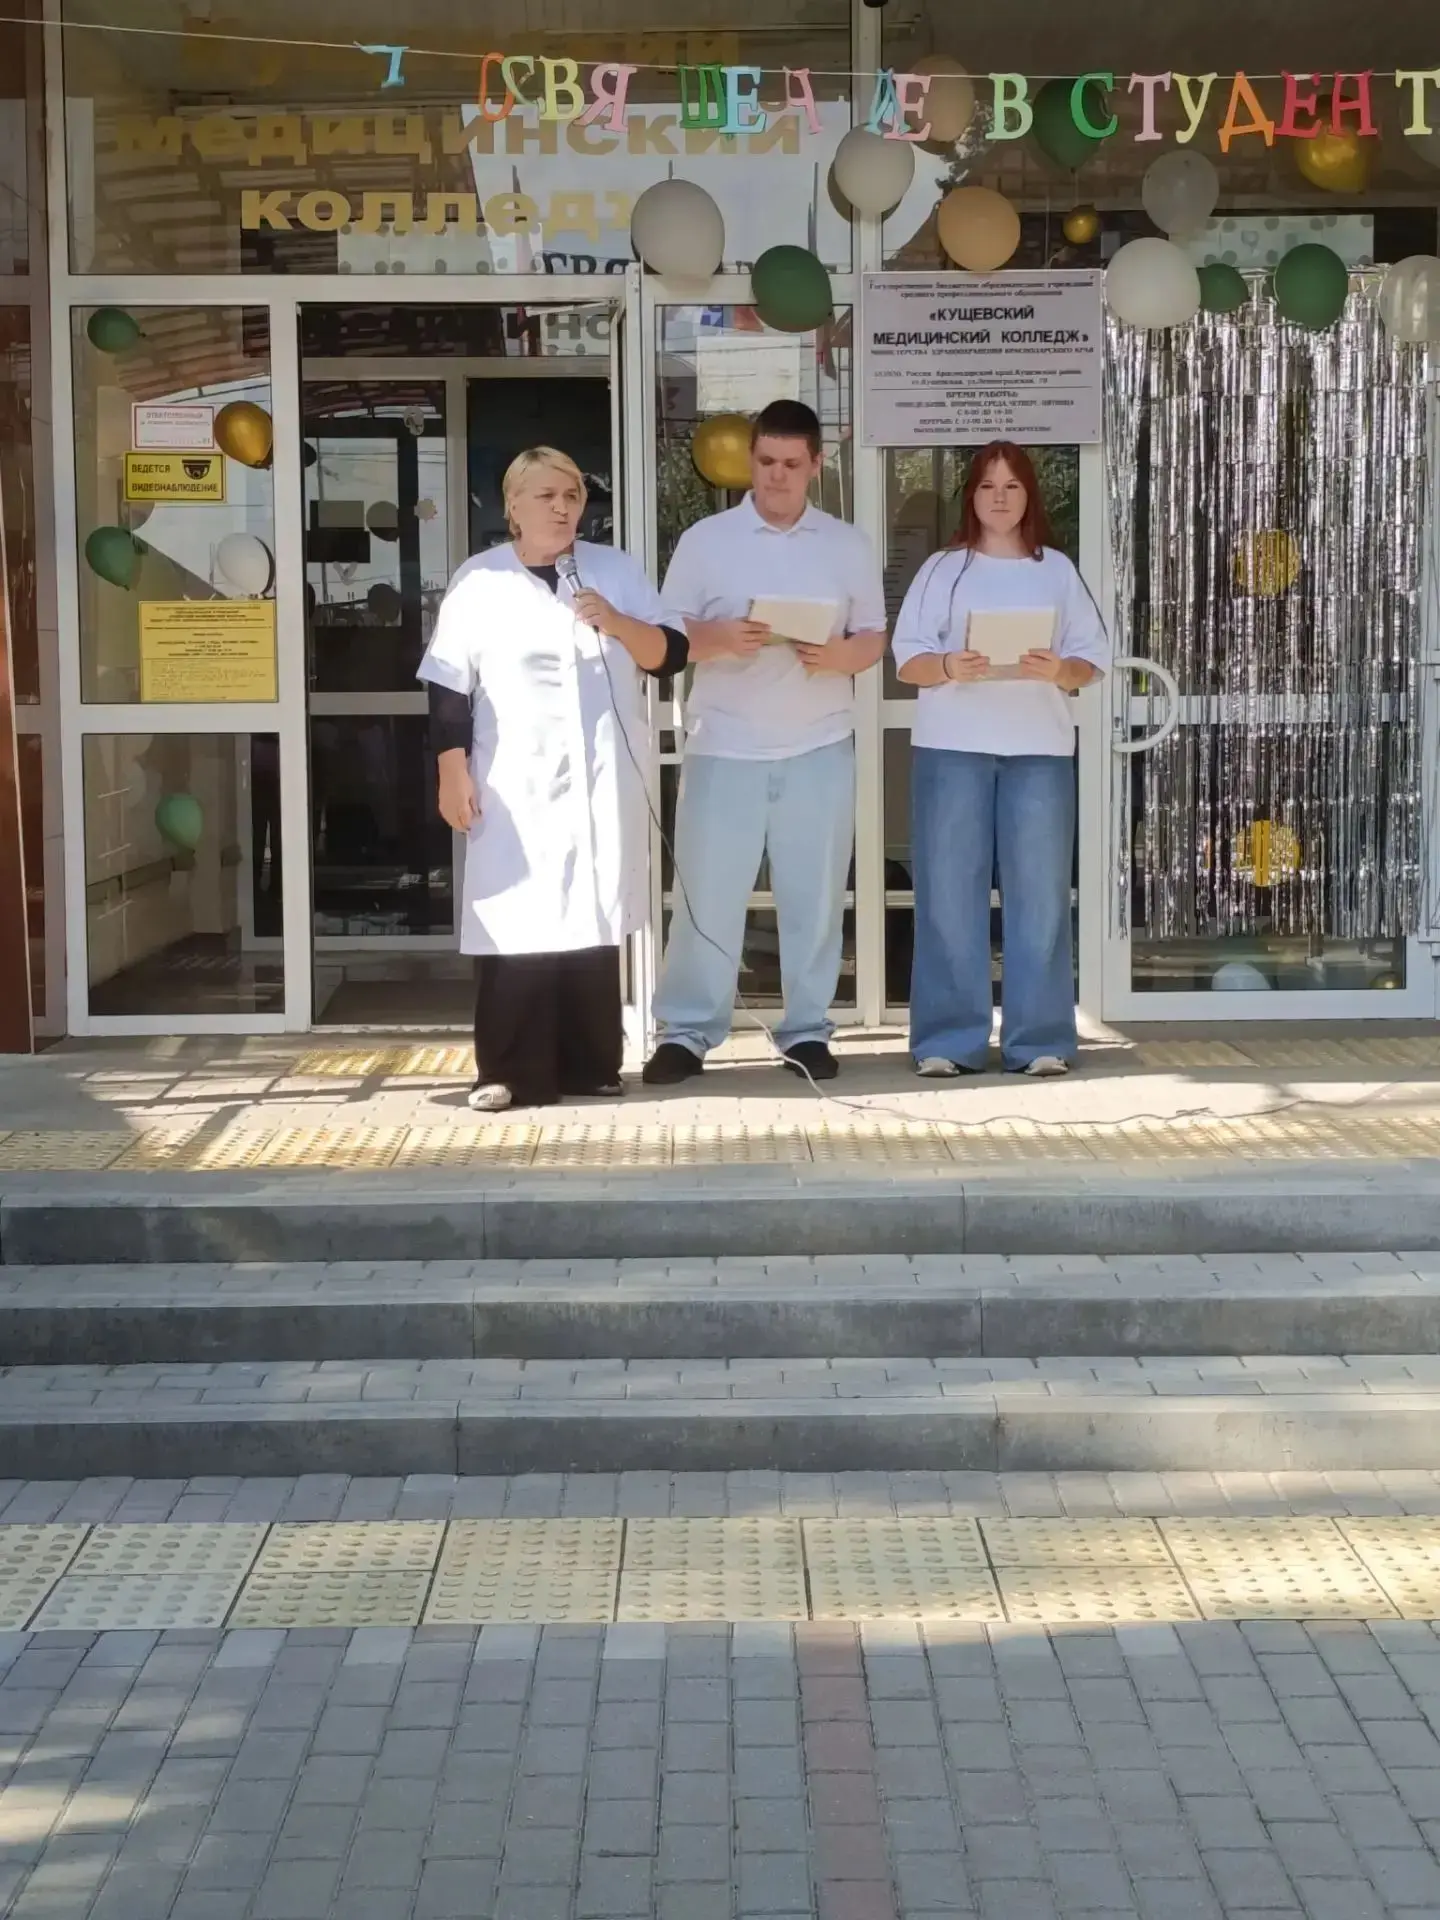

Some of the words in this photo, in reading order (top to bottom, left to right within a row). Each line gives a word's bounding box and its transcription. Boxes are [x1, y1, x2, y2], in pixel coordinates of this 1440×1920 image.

[985, 73, 1034, 141] В
[1070, 69, 1440, 153] СТУДЕНТ
[929, 305, 1034, 322] «КУЩЕВСКИЙ
[873, 329, 991, 346] МЕДИЦИНСКИЙ
[1002, 330, 1089, 345] КОЛЛЕДЖ»
